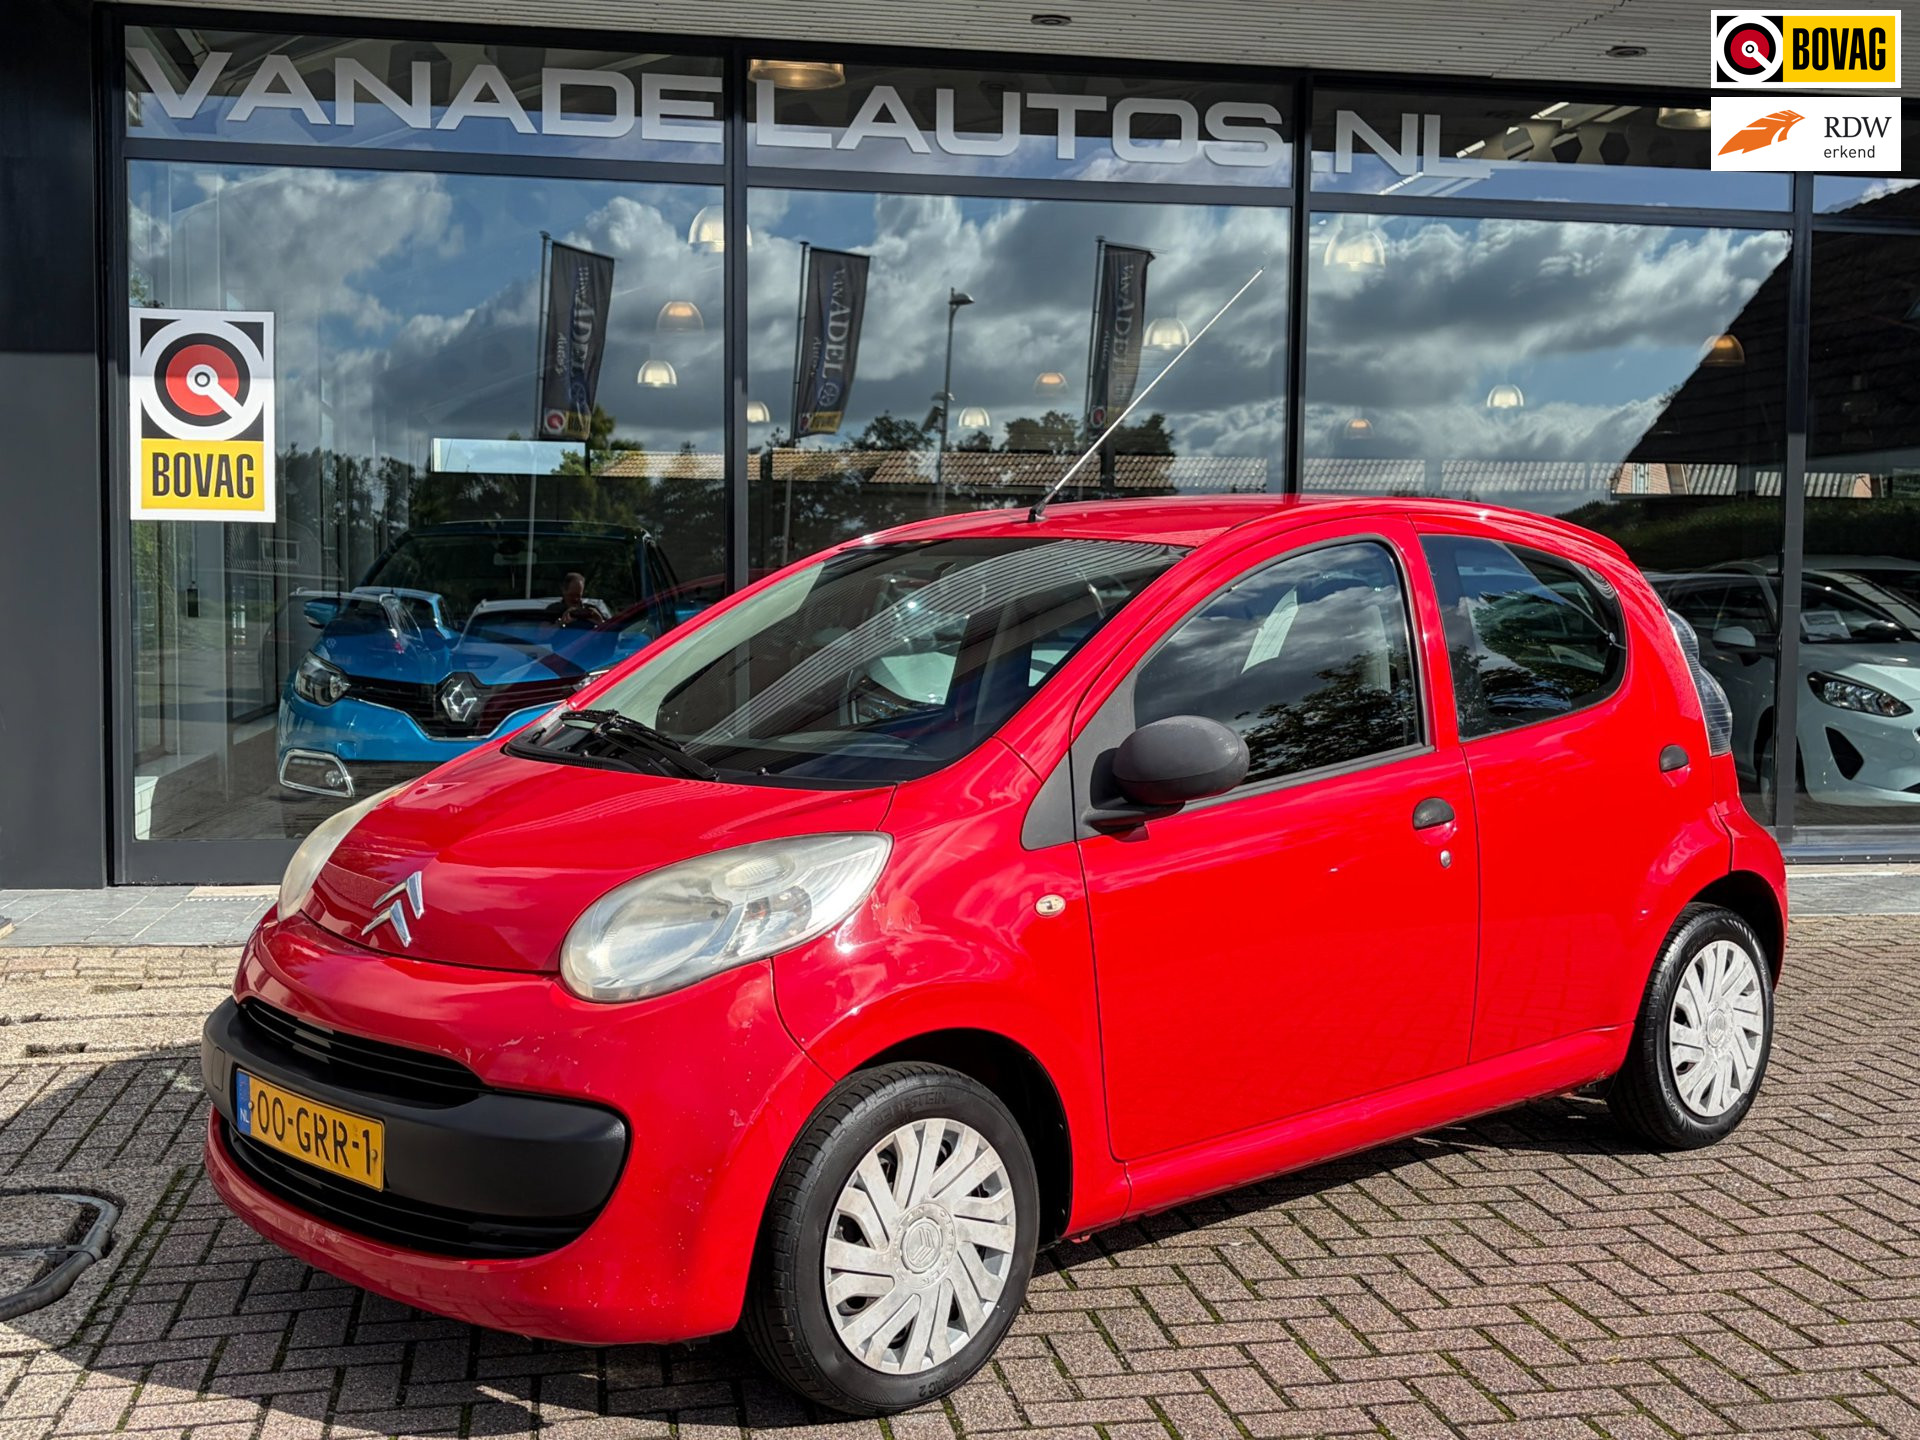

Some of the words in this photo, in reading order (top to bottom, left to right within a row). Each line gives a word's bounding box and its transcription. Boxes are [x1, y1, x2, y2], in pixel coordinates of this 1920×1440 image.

[152, 452, 255, 499] BOVAG
[239, 1107, 250, 1123] NL
[257, 1090, 370, 1176] 00-GRR-1
